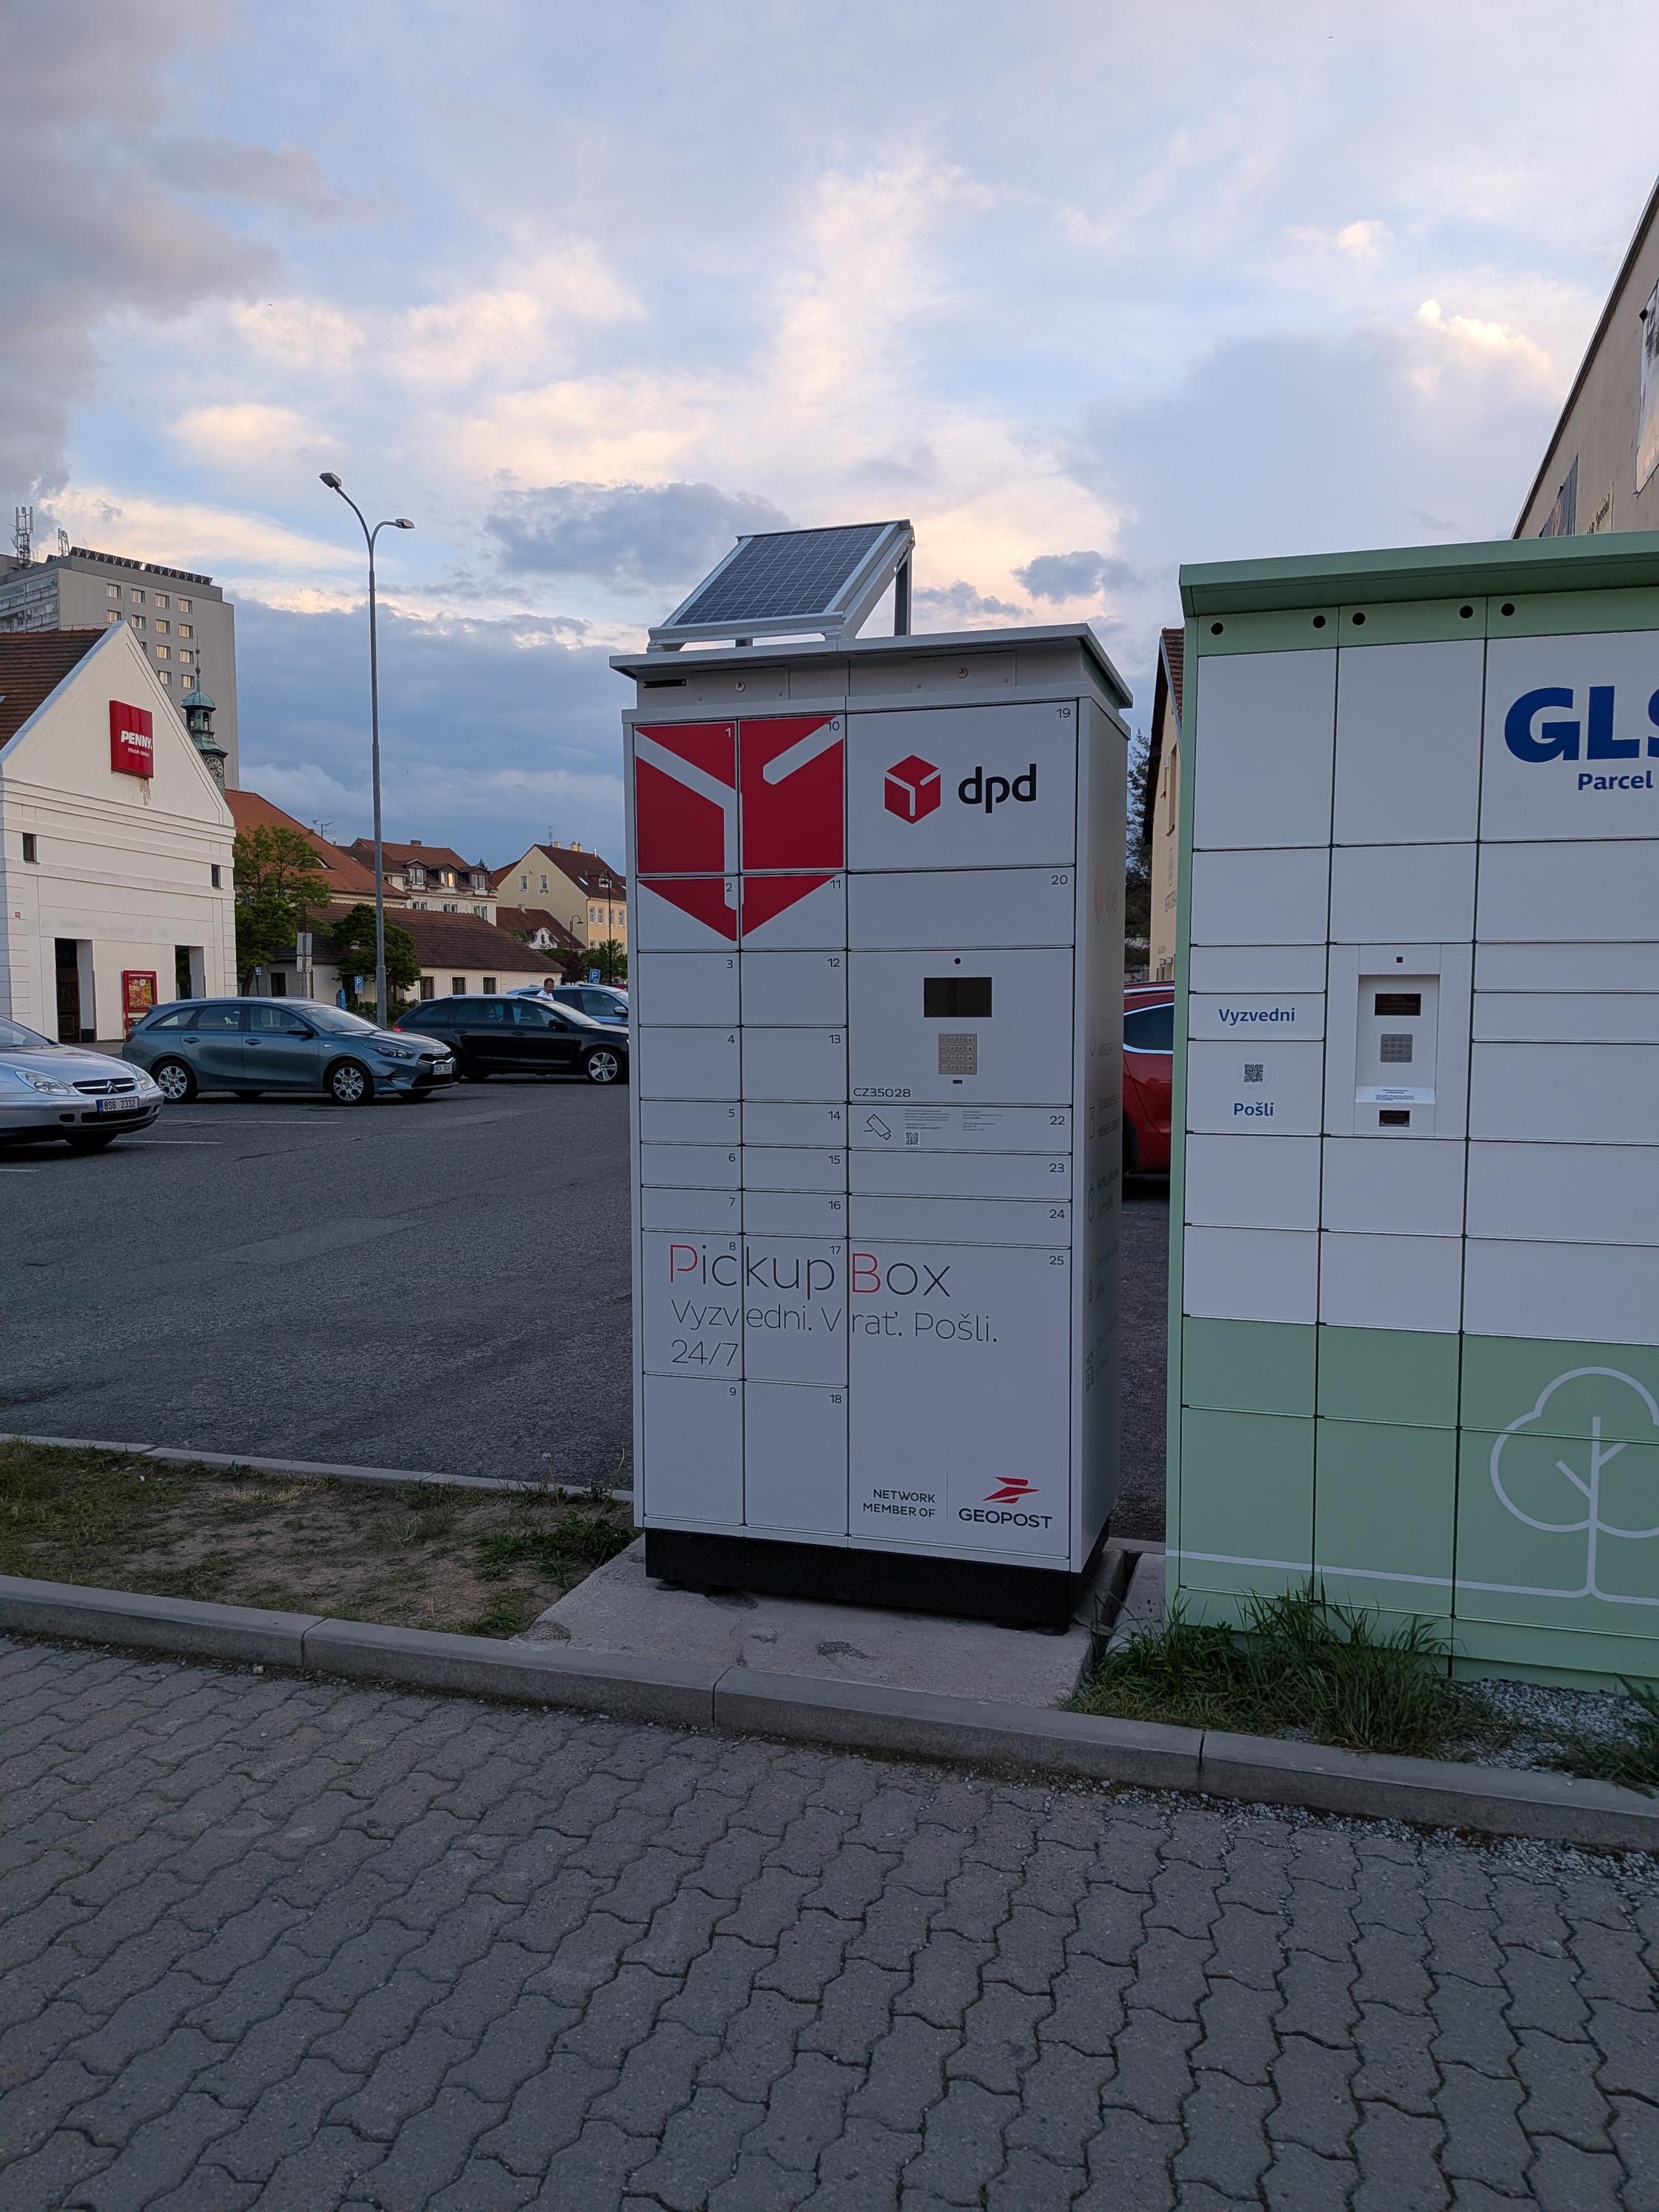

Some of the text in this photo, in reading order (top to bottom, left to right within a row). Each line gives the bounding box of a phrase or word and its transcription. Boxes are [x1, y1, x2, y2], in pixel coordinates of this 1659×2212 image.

[1056, 707, 1071, 719] 19
[826, 721, 840, 731] 10
[725, 727, 731, 738] 1
[1578, 771, 1653, 790] Parcel
[958, 762, 1037, 814] dpd
[830, 879, 841, 889] 11
[1051, 874, 1068, 886] 20
[726, 882, 733, 892] 2
[726, 959, 734, 969] 3
[827, 958, 841, 967] 12
[1218, 1007, 1295, 1026] Vyzvedni
[727, 1034, 735, 1044] 4
[828, 1034, 842, 1044] 13
[853, 1088, 911, 1098] CZ35028
[104, 1099, 136, 1110] 8S6 2332
[1234, 1101, 1274, 1116] Pošli
[728, 1108, 735, 1118] 5
[827, 1110, 841, 1121] 14
[1049, 1115, 1065, 1126] 22
[728, 1152, 736, 1163] 6
[828, 1155, 841, 1165] 15
[1049, 1163, 1065, 1173] 23
[728, 1197, 736, 1206] 7
[827, 1200, 841, 1210] 16
[1049, 1208, 1065, 1220] 24
[728, 1241, 737, 1251] 8
[829, 1245, 841, 1255] 17
[1048, 1255, 1065, 1265] 25
[671, 1298, 813, 1331] Vyzvedni.
[915, 1312, 998, 1343] Pošli.
[672, 1339, 739, 1367] 24/7
[729, 1387, 737, 1397] 9
[829, 1394, 844, 1404] 18
[873, 1489, 936, 1504] NETWORK
[863, 1502, 936, 1518] MEMBER OF
[959, 1508, 1053, 1529] GEOPOST
